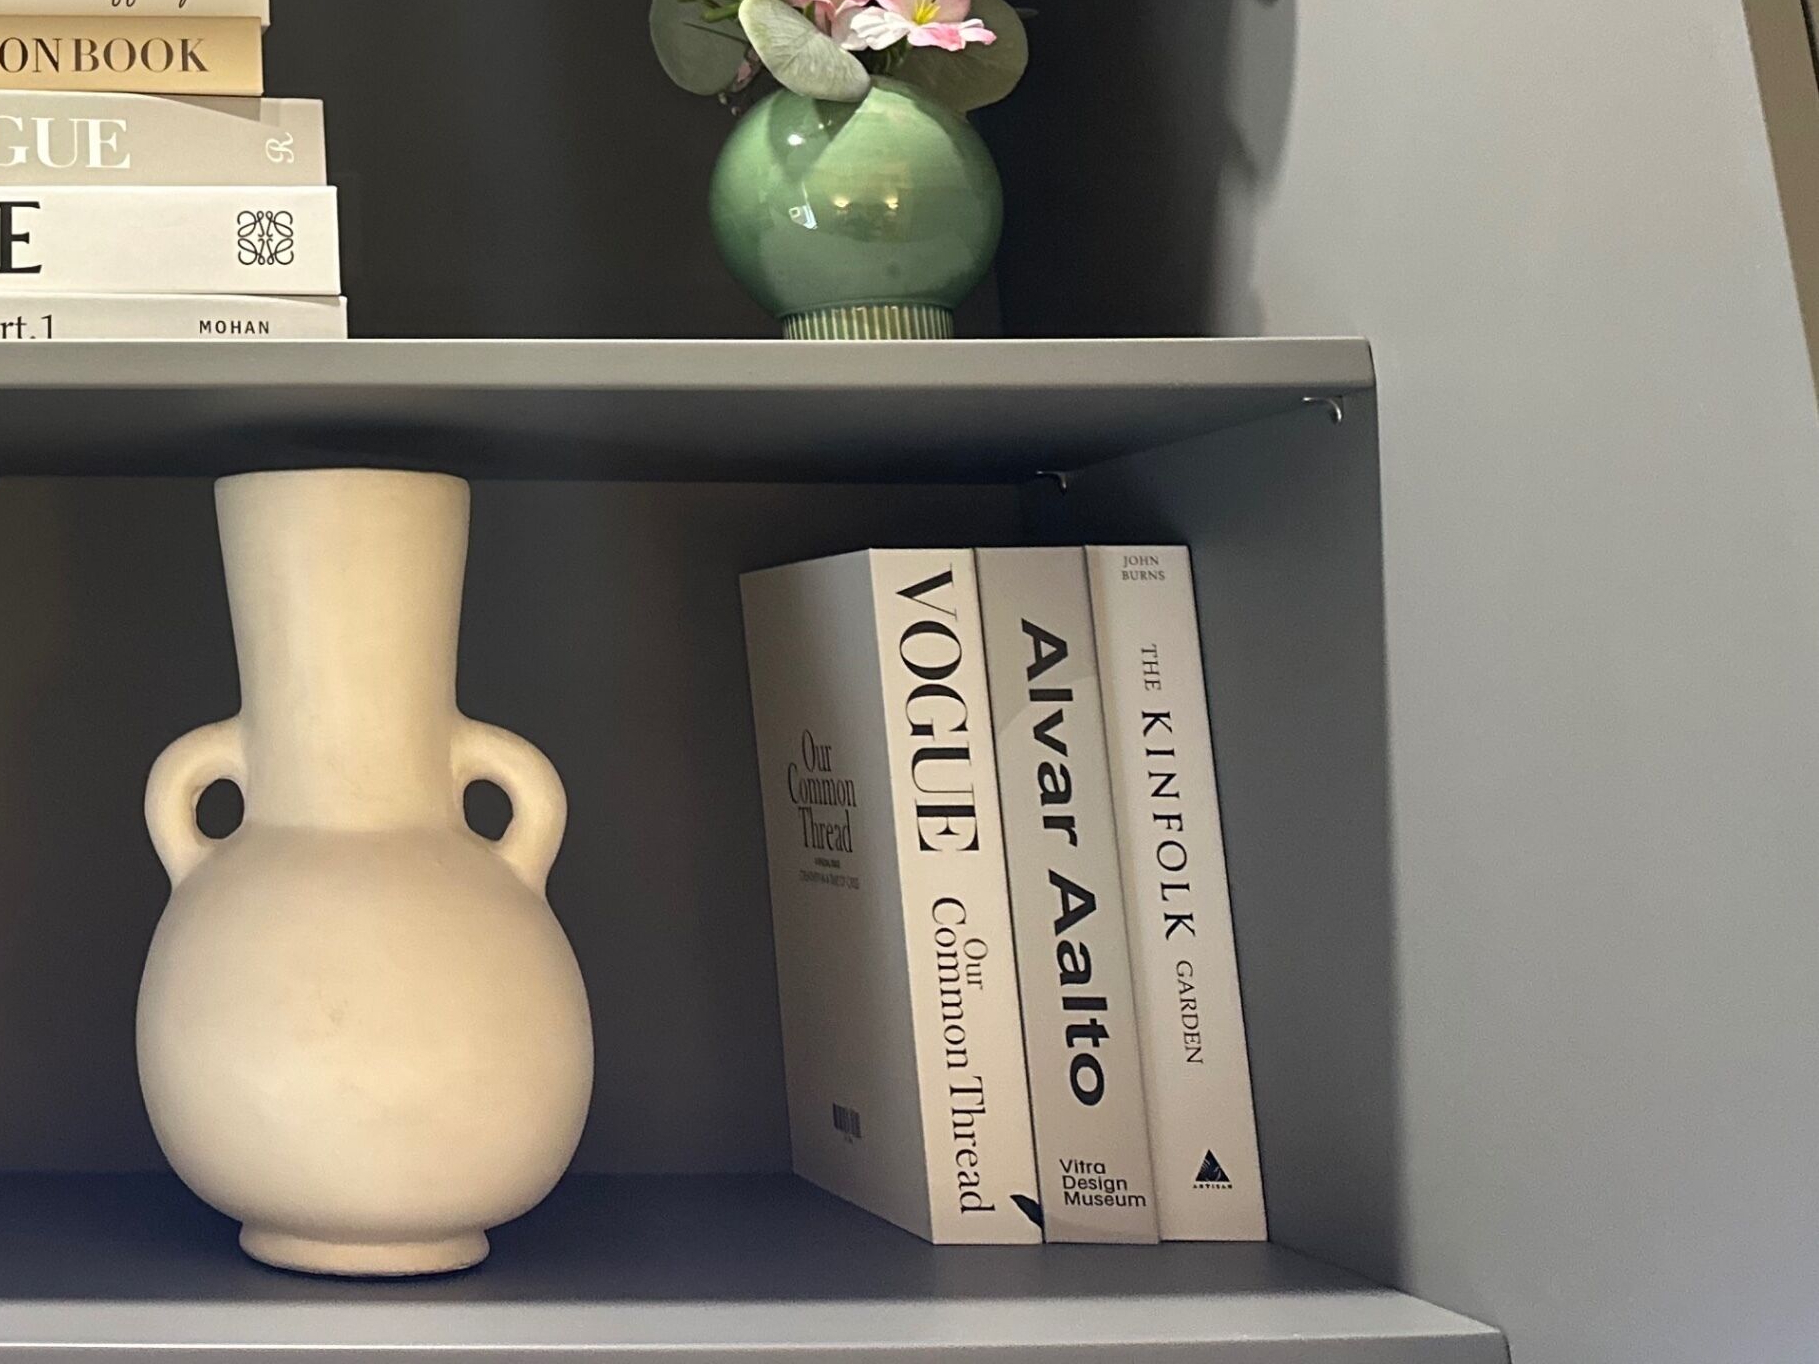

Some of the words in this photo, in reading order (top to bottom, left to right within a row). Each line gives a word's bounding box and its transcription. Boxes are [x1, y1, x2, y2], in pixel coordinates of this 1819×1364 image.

[74, 38, 208, 72] BOOK
[199, 320, 269, 334] MOHAN
[1121, 570, 1166, 581] BURNS
[1123, 555, 1159, 568] JOHN
[1141, 644, 1161, 691] THE
[894, 563, 982, 853] VOGUE
[1020, 617, 1078, 847] Alvar
[801, 729, 832, 773] Our
[787, 761, 858, 809] Common
[797, 805, 855, 854] Thread
[1141, 710, 1197, 942] KINFOLK
[932, 897, 971, 1069] Common
[964, 938, 987, 990] Our
[1048, 868, 1110, 1107] Aalto
[1176, 960, 1204, 1064] GARDEN
[949, 1075, 996, 1214] Thread
[1059, 1158, 1106, 1175] Vitra
[1062, 1172, 1128, 1194] Design
[1063, 1188, 1147, 1207] Museum
